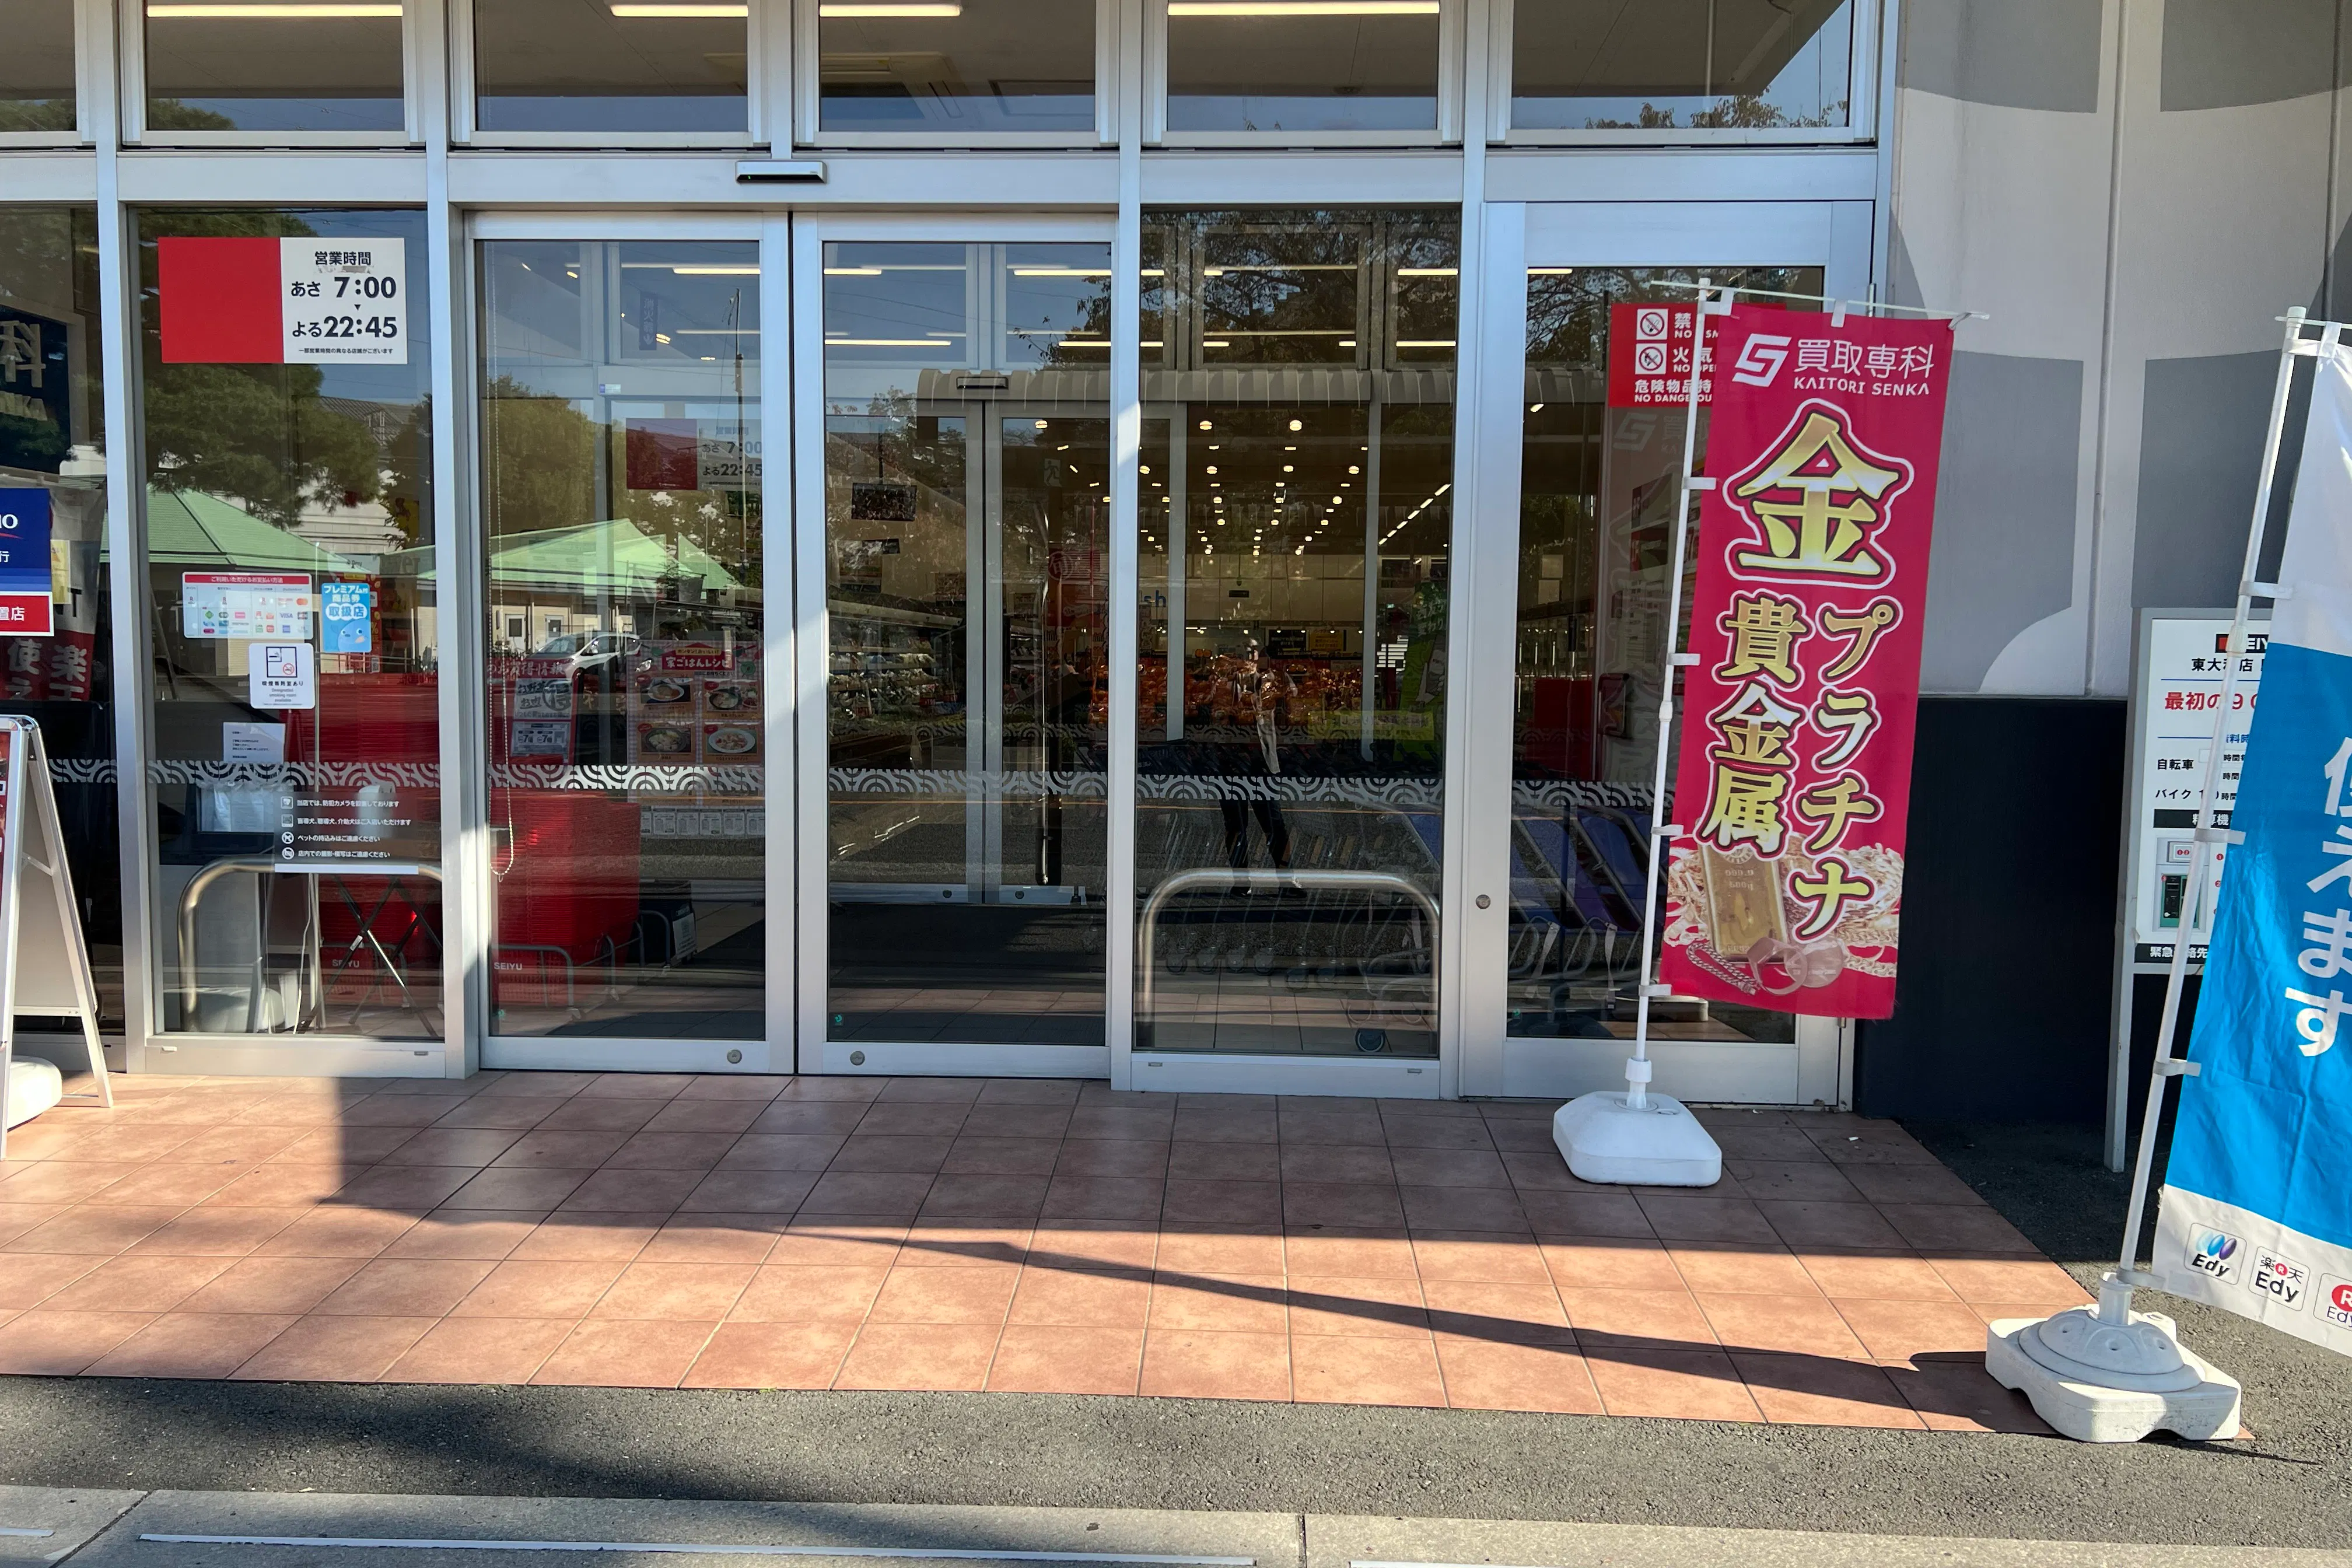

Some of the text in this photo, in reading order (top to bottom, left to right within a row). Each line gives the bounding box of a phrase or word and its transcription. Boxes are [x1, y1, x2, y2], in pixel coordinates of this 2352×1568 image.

[315, 251, 372, 265] 営業時間
[290, 276, 397, 299] あさ 7:00
[1674, 330, 1693, 338] NO
[1794, 338, 1935, 379] 買取専科
[1673, 364, 1690, 373] NO
[1793, 377, 1930, 396] KAITORI SENKA
[1634, 394, 1651, 402] NO
[1731, 407, 1904, 580] 金
[328, 606, 365, 617] 取扱店
[2191, 657, 2253, 672] 東大店
[1702, 594, 1808, 852] 貴金属
[1794, 601, 1896, 939] プラチナ
[2157, 758, 2194, 771] 自転車
[2155, 789, 2192, 800] バイク
[494, 961, 523, 971] SEIYU
[2191, 1253, 2230, 1278] Edy
[2255, 1270, 2300, 1304] Edy
